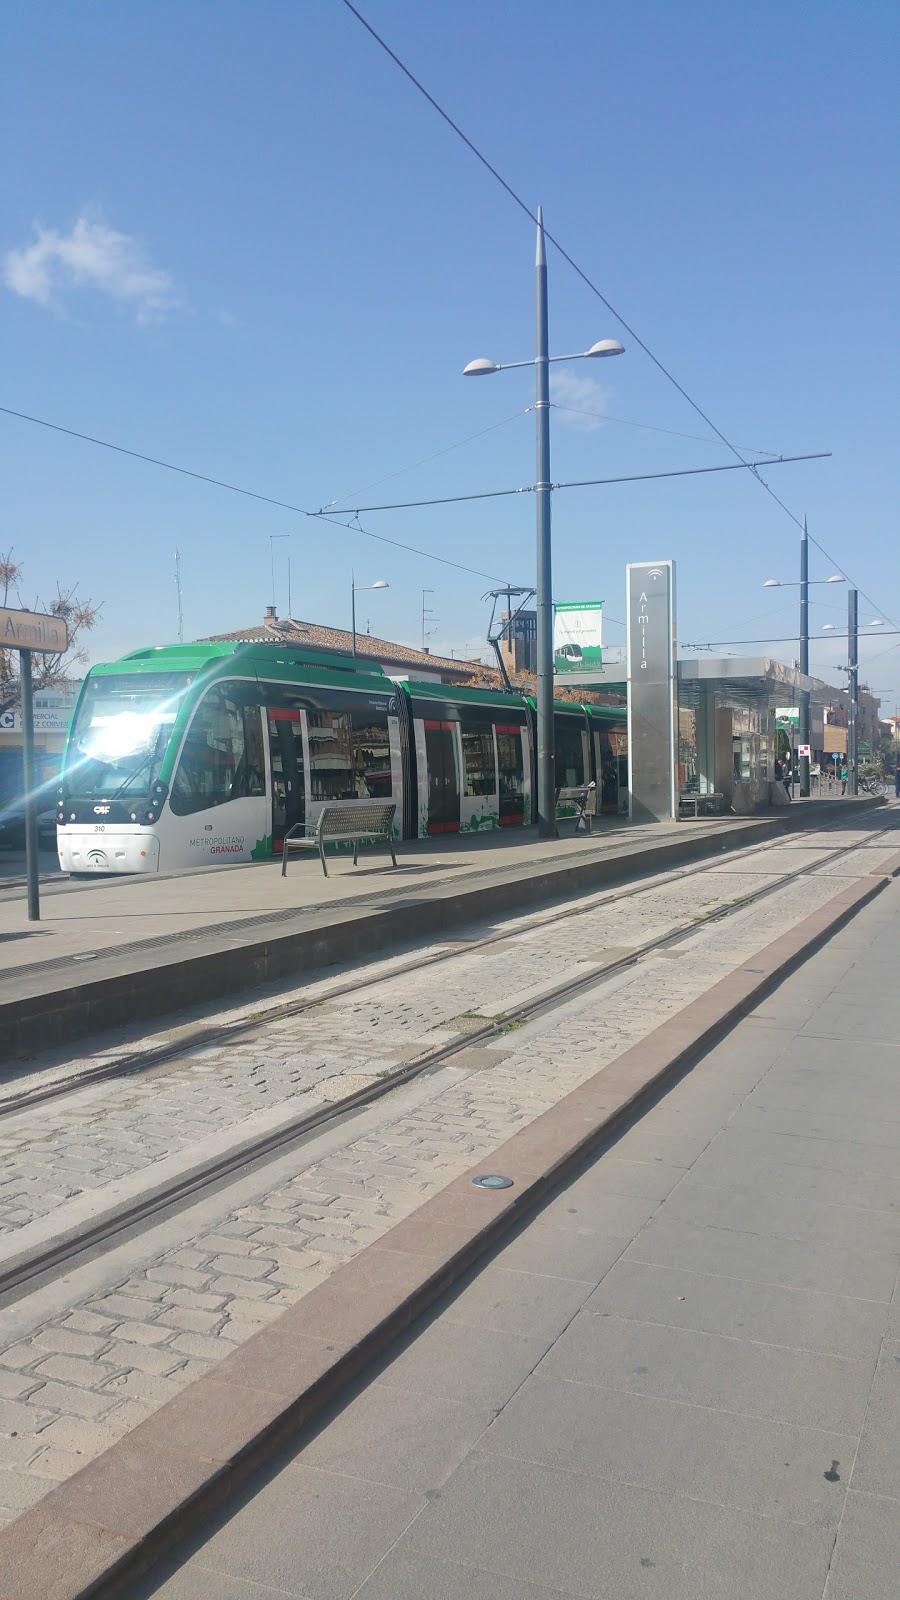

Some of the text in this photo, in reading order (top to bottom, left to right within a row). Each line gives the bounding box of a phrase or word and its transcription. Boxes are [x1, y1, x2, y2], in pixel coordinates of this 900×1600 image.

[5, 616, 59, 643] Armilla
[638, 592, 649, 669] Armilla
[94, 806, 110, 814] CAF
[190, 836, 245, 847] METROPOLITANO
[210, 845, 243, 854] GRANADA
